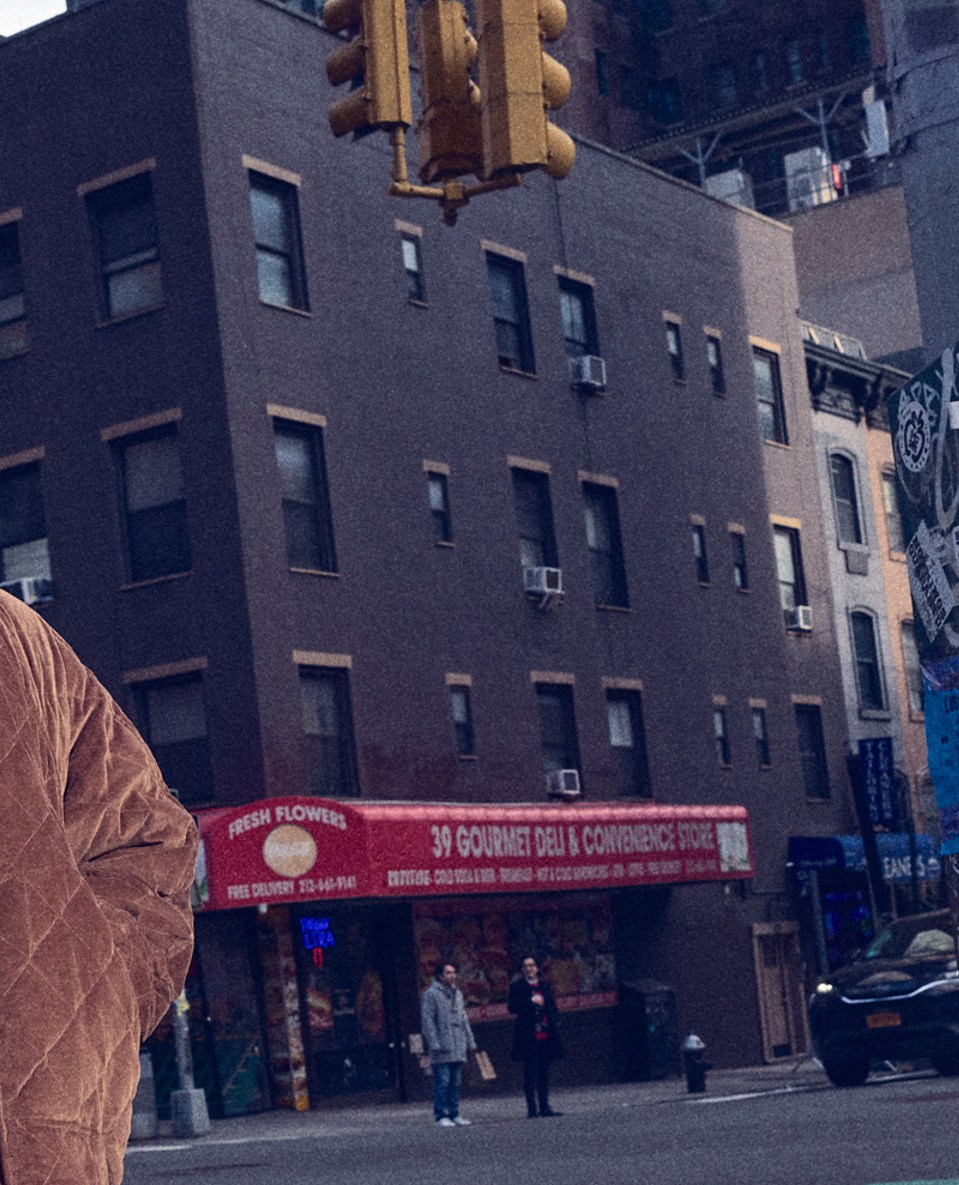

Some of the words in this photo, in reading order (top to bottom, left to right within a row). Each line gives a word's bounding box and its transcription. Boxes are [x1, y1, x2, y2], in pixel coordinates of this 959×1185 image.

[228, 808, 271, 841] FRESH
[275, 805, 347, 831] FLOWERS
[431, 825, 451, 858] 39
[456, 825, 531, 858] GOURMET
[534, 826, 566, 857] DELI
[568, 826, 580, 857] &
[583, 823, 675, 856] CONVENIENCE
[677, 822, 715, 849] STORE
[227, 883, 250, 900] FREE
[251, 880, 295, 898] DELIVERY
